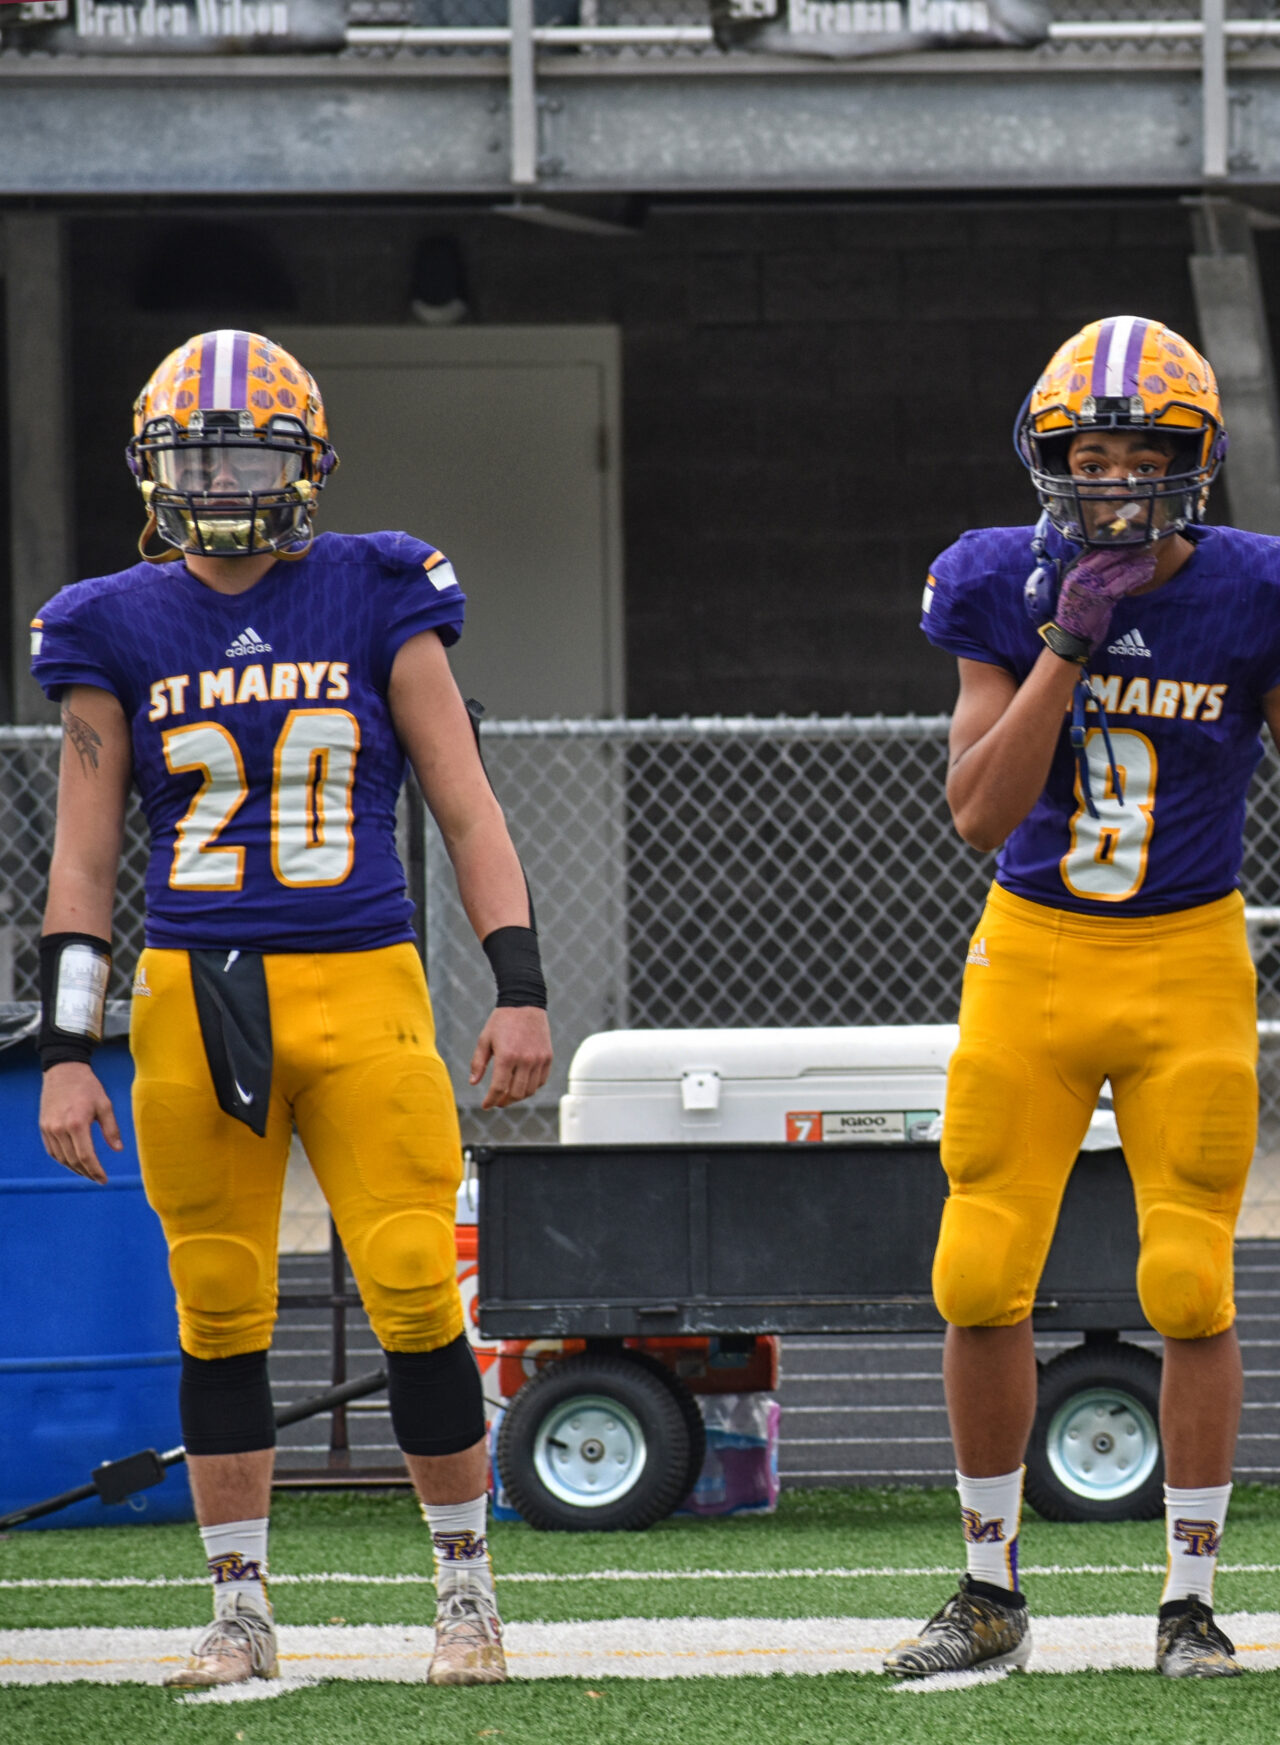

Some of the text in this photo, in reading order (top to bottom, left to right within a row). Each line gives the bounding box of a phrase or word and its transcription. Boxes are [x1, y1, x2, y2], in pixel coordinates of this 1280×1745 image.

[76, 0, 189, 44] Brayden
[197, 0, 288, 35] Wilson
[225, 643, 272, 657] adidas
[1107, 645, 1152, 657] adidas
[149, 661, 349, 722] ST MARYS
[1086, 674, 1228, 722] MARYS
[161, 707, 361, 891] 20
[1059, 727, 1158, 902] 8
[795, 1121, 812, 1141] 7
[840, 1116, 887, 1127] IGLOO
